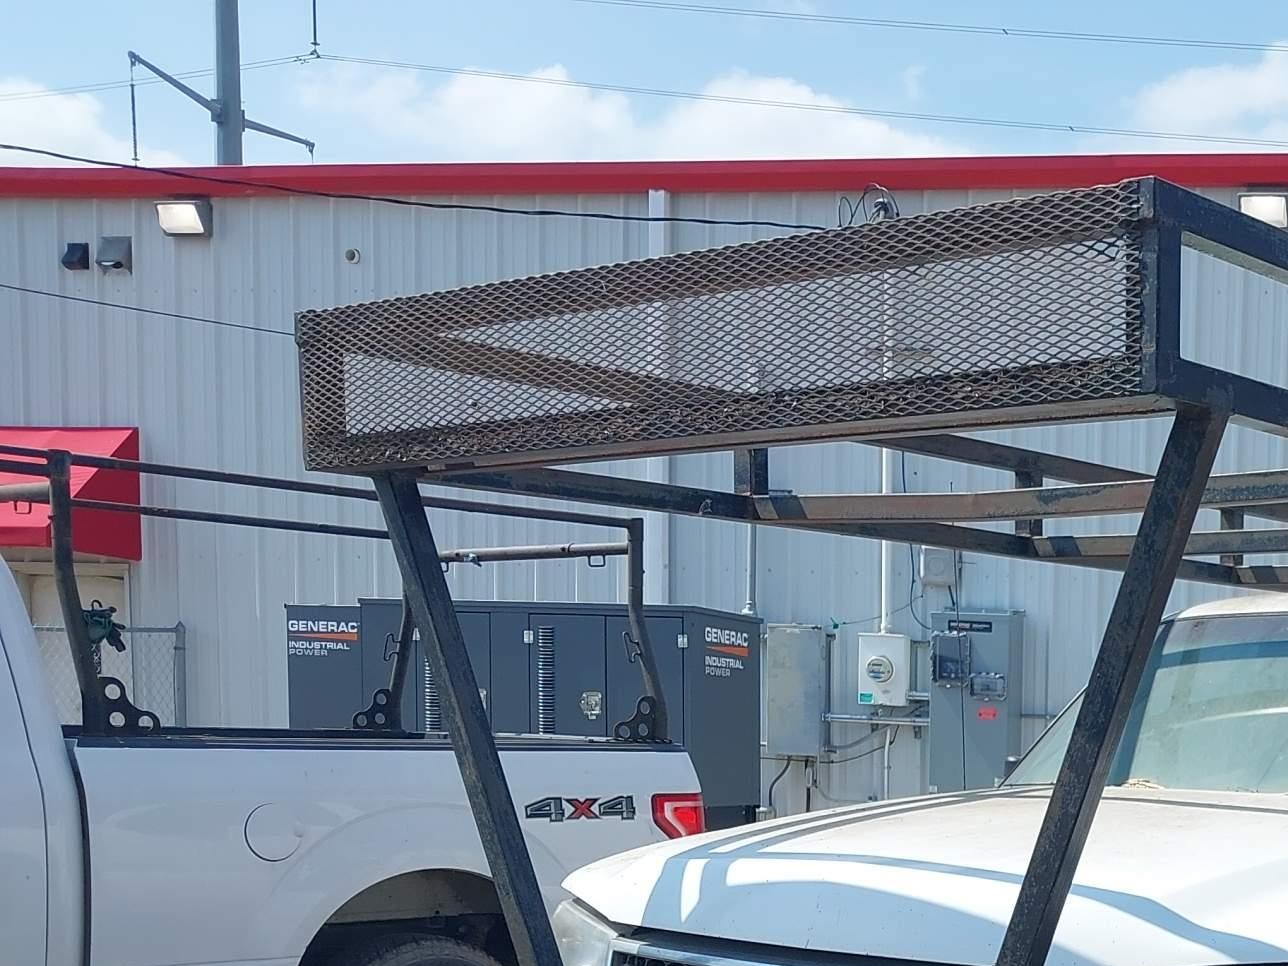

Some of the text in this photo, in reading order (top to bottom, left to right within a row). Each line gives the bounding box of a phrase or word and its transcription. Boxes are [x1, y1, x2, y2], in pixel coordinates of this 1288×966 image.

[288, 620, 358, 632] GENERAC
[704, 627, 748, 647] GENERAC
[288, 640, 350, 650] INDUSTRIAL
[288, 648, 328, 656] POWER
[704, 655, 744, 670] INDUSTRIAL
[705, 666, 731, 677] POWER
